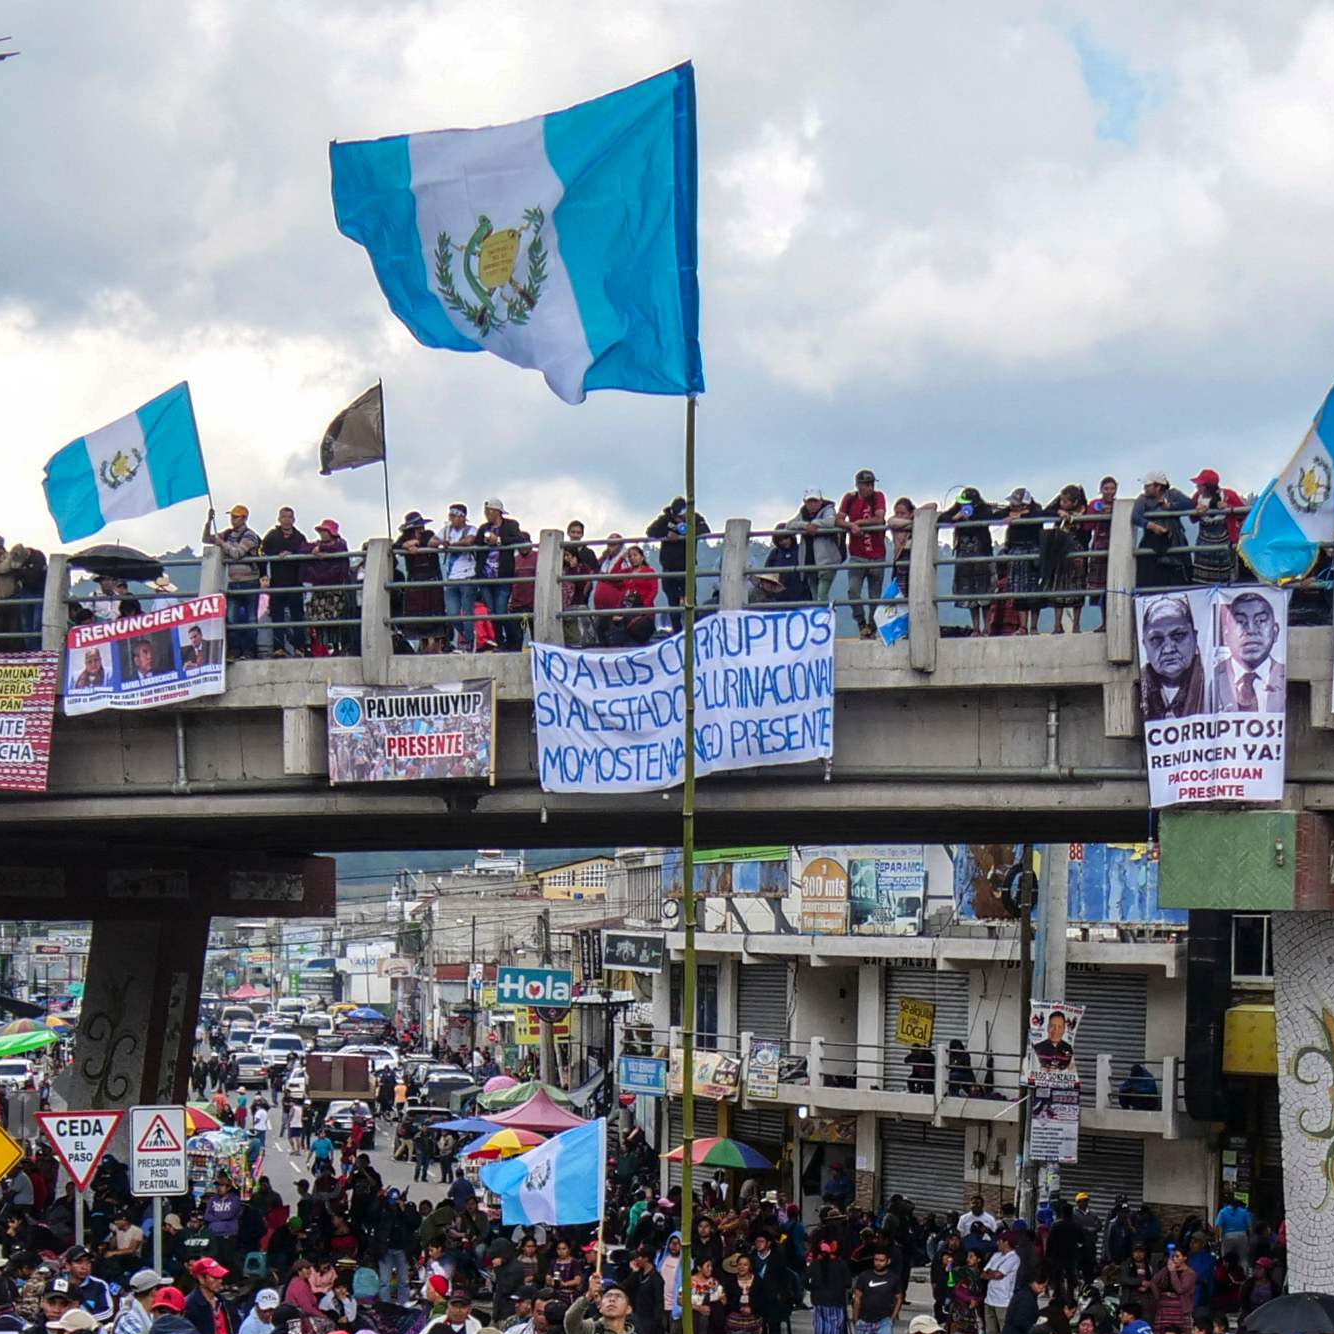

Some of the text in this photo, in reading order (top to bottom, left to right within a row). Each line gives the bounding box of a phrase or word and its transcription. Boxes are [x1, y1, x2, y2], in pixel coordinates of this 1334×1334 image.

[75, 598, 220, 647] ¡RENUNCIEN YA!
[534, 608, 832, 689] NO A LOS CORRUPTOS
[537, 692, 561, 727] SI
[567, 697, 598, 731] AL
[1148, 719, 1283, 746] CORRUPTOS!
[387, 734, 462, 757] PRESENTE
[543, 708, 831, 784] MOMOSTENANGO PRESENTE
[1243, 744, 1281, 761] YA!
[1179, 785, 1245, 799] PRESENTE
[802, 875, 823, 897] 300
[498, 974, 568, 1000] Hola
[901, 1018, 928, 1041] Local
[56, 1118, 104, 1137] CEDA
[68, 1152, 94, 1162] PASO
[75, 1141, 86, 1151] EL
[137, 1156, 181, 1168] PRECAUCIÓN
[150, 1168, 169, 1178] PASO
[139, 1179, 180, 1190] PEATONAL
